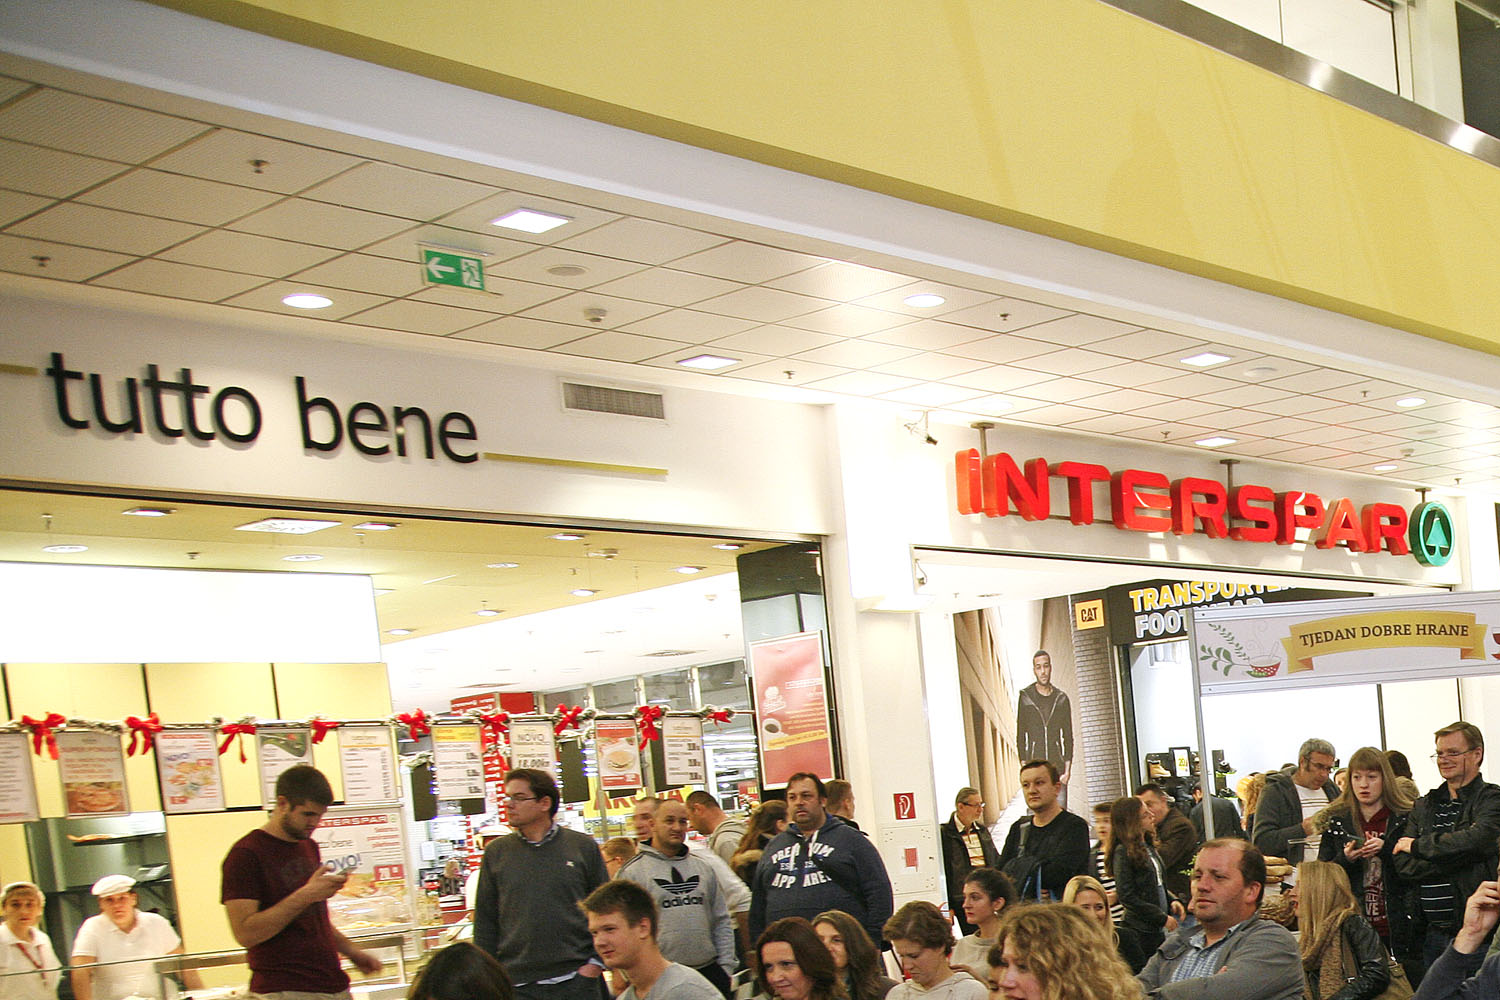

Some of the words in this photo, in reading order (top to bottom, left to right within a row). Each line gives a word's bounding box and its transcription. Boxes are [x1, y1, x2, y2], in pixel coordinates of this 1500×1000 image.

[46, 352, 264, 444] tutto
[294, 375, 480, 464] bene
[954, 447, 1413, 557] INTERSPAR
[1080, 606, 1098, 622] CAT
[1299, 627, 1357, 648] TJEDAN
[1361, 624, 1412, 639] DOBRE
[1415, 623, 1470, 637] HRANE
